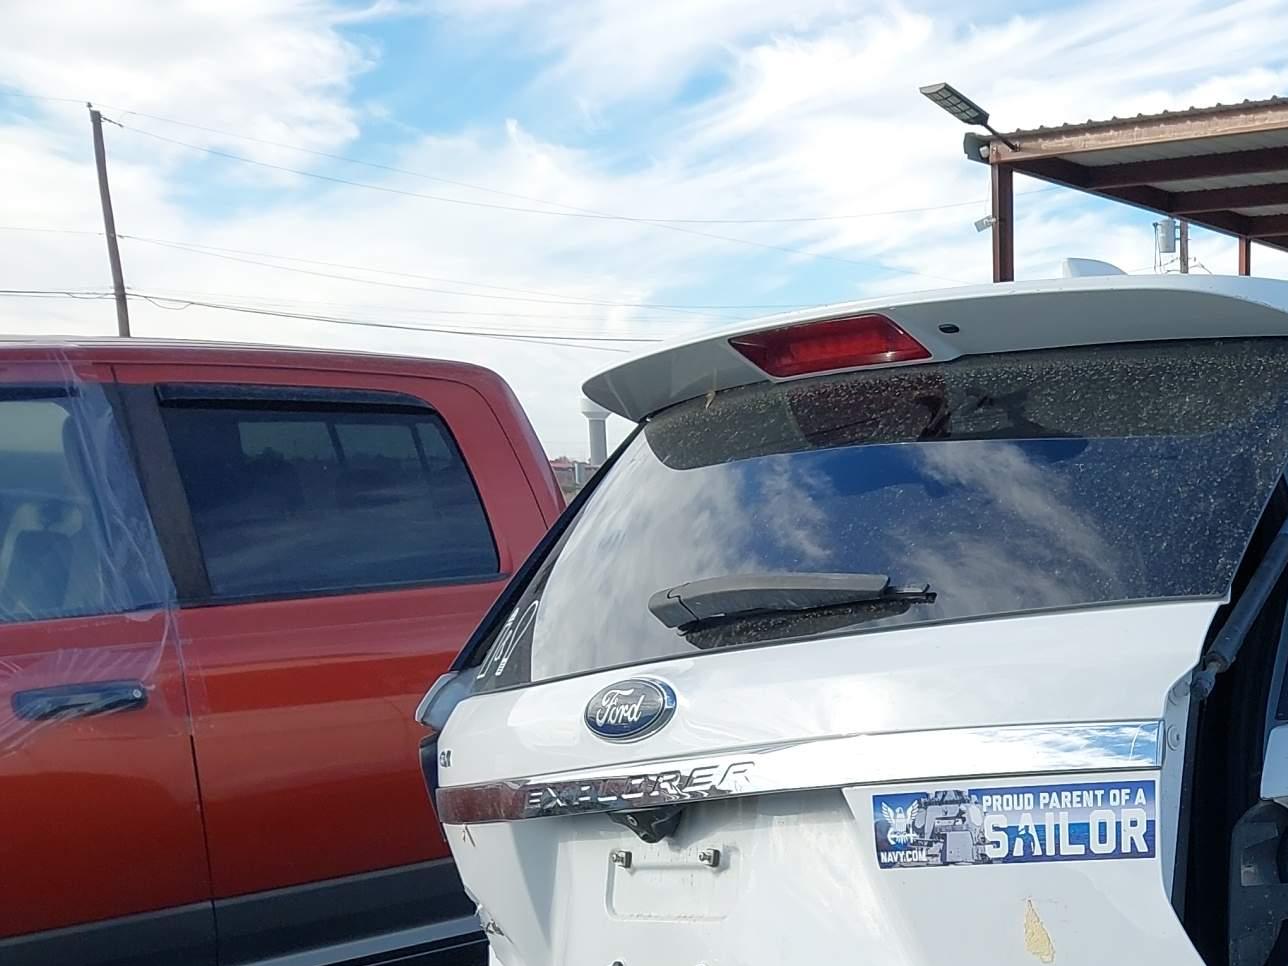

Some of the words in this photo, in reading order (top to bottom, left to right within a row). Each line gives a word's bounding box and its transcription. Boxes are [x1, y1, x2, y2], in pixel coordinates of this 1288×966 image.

[596, 688, 645, 727] Ford
[982, 793, 1034, 812] PROUD
[1039, 789, 1104, 809] PARENT
[1109, 789, 1130, 806] OF
[1135, 788, 1147, 806] A
[983, 808, 1149, 859] SAILOR
[880, 849, 928, 864] NAVY.COM
